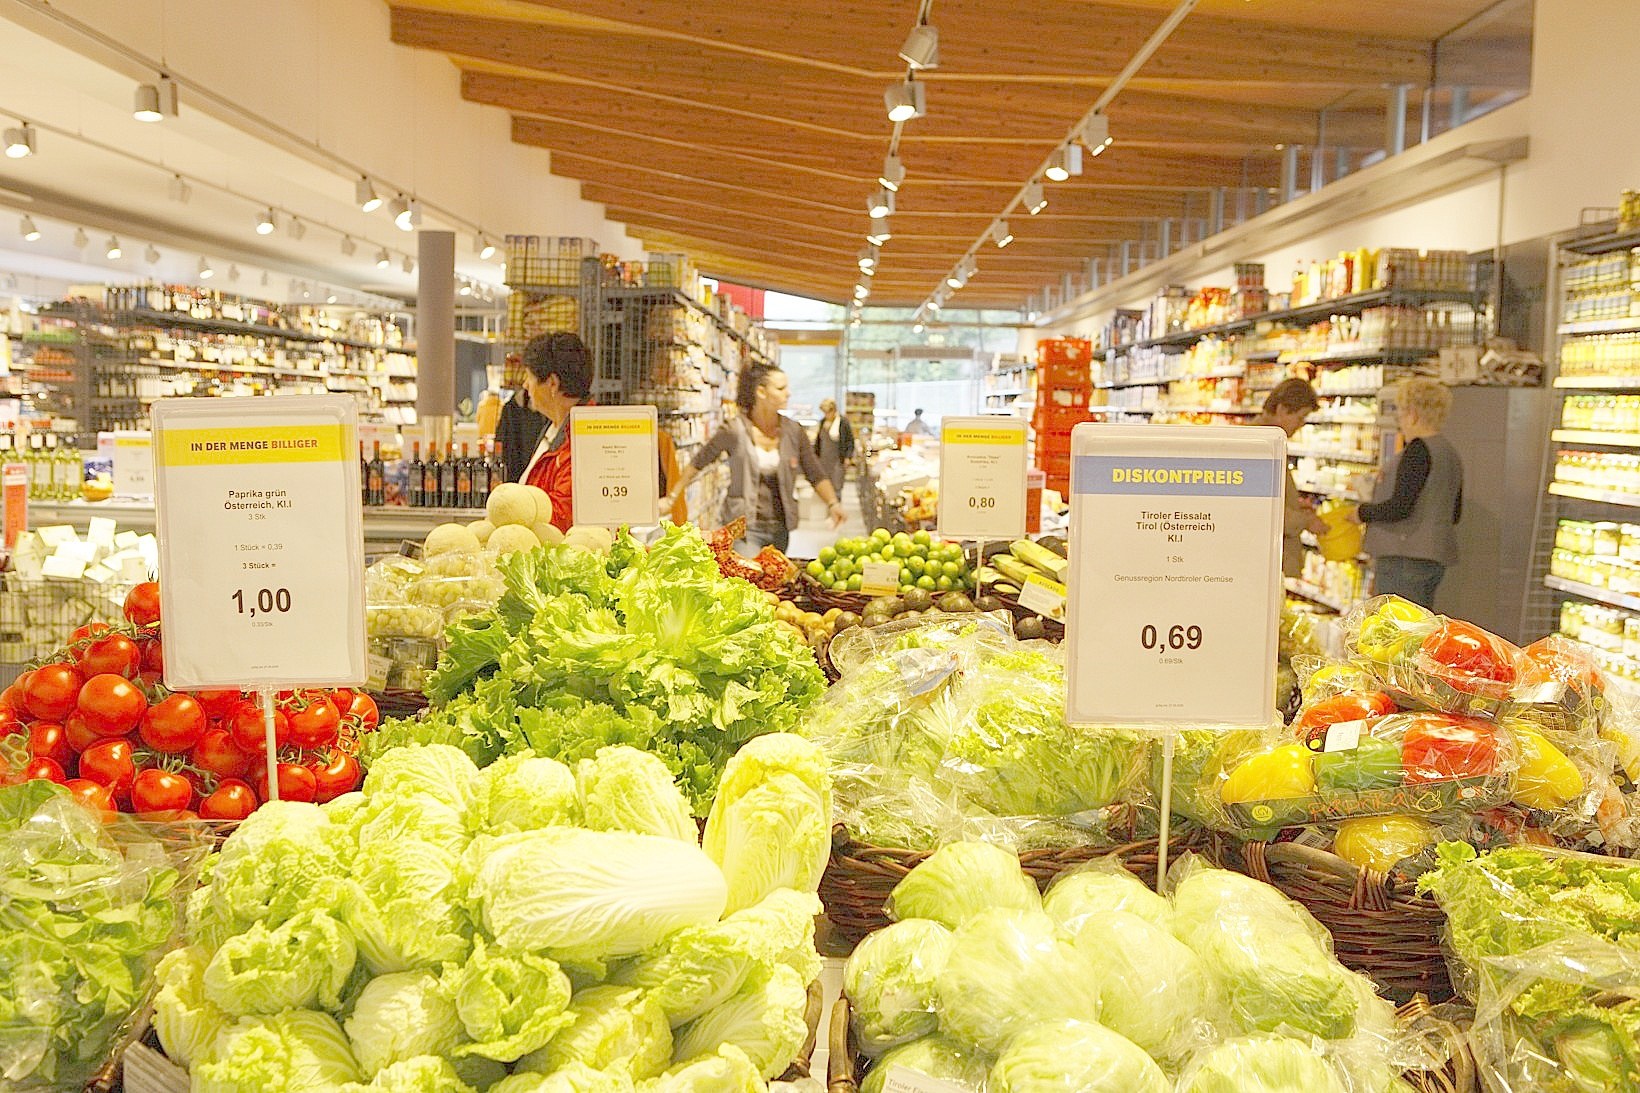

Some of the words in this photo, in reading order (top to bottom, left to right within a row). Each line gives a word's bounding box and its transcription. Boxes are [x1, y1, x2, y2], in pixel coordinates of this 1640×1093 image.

[190, 442, 203, 452] IN
[205, 442, 227, 451] DER
[229, 440, 268, 450] MENGE
[271, 439, 318, 449] BILLIGER
[1112, 468, 1244, 485] DISKONTPREIS
[228, 489, 263, 499] Paprika
[265, 489, 287, 499] grün
[602, 486, 628, 499] 0,39
[224, 500, 275, 510] Österreich,
[969, 496, 995, 510] 0,80
[1141, 511, 1172, 520] Tiroler
[1174, 511, 1211, 521] Eissalat
[1136, 521, 1158, 531] Tirol
[1160, 521, 1216, 532] (Österreich)
[240, 543, 260, 551] Stück
[1172, 555, 1184, 563] Stk
[248, 561, 270, 570] Stück
[1114, 574, 1163, 583] Genussregion
[1165, 574, 1202, 583] Nordtiroler
[1203, 574, 1234, 583] Gemüse
[231, 588, 291, 618] 1,00
[1141, 624, 1203, 654] 0,69
